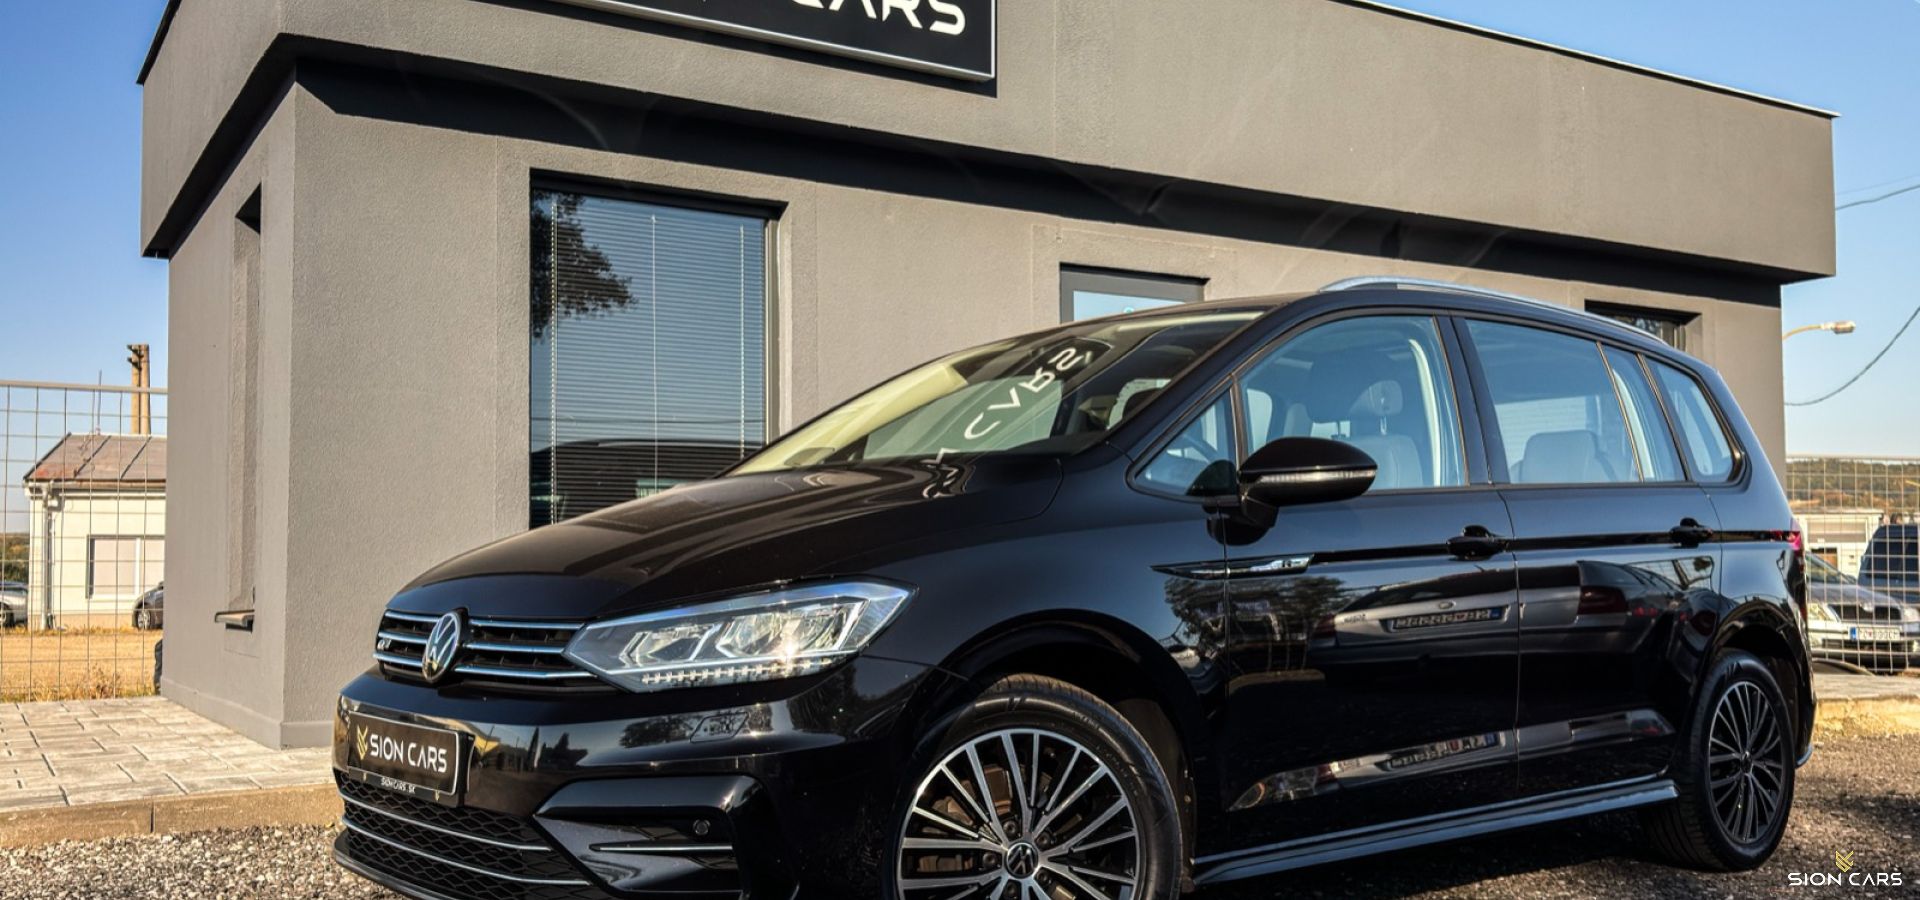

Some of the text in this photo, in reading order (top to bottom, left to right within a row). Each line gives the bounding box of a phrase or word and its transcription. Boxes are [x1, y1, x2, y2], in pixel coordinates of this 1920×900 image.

[792, 0, 966, 35] RS
[370, 733, 447, 773] SION CARS
